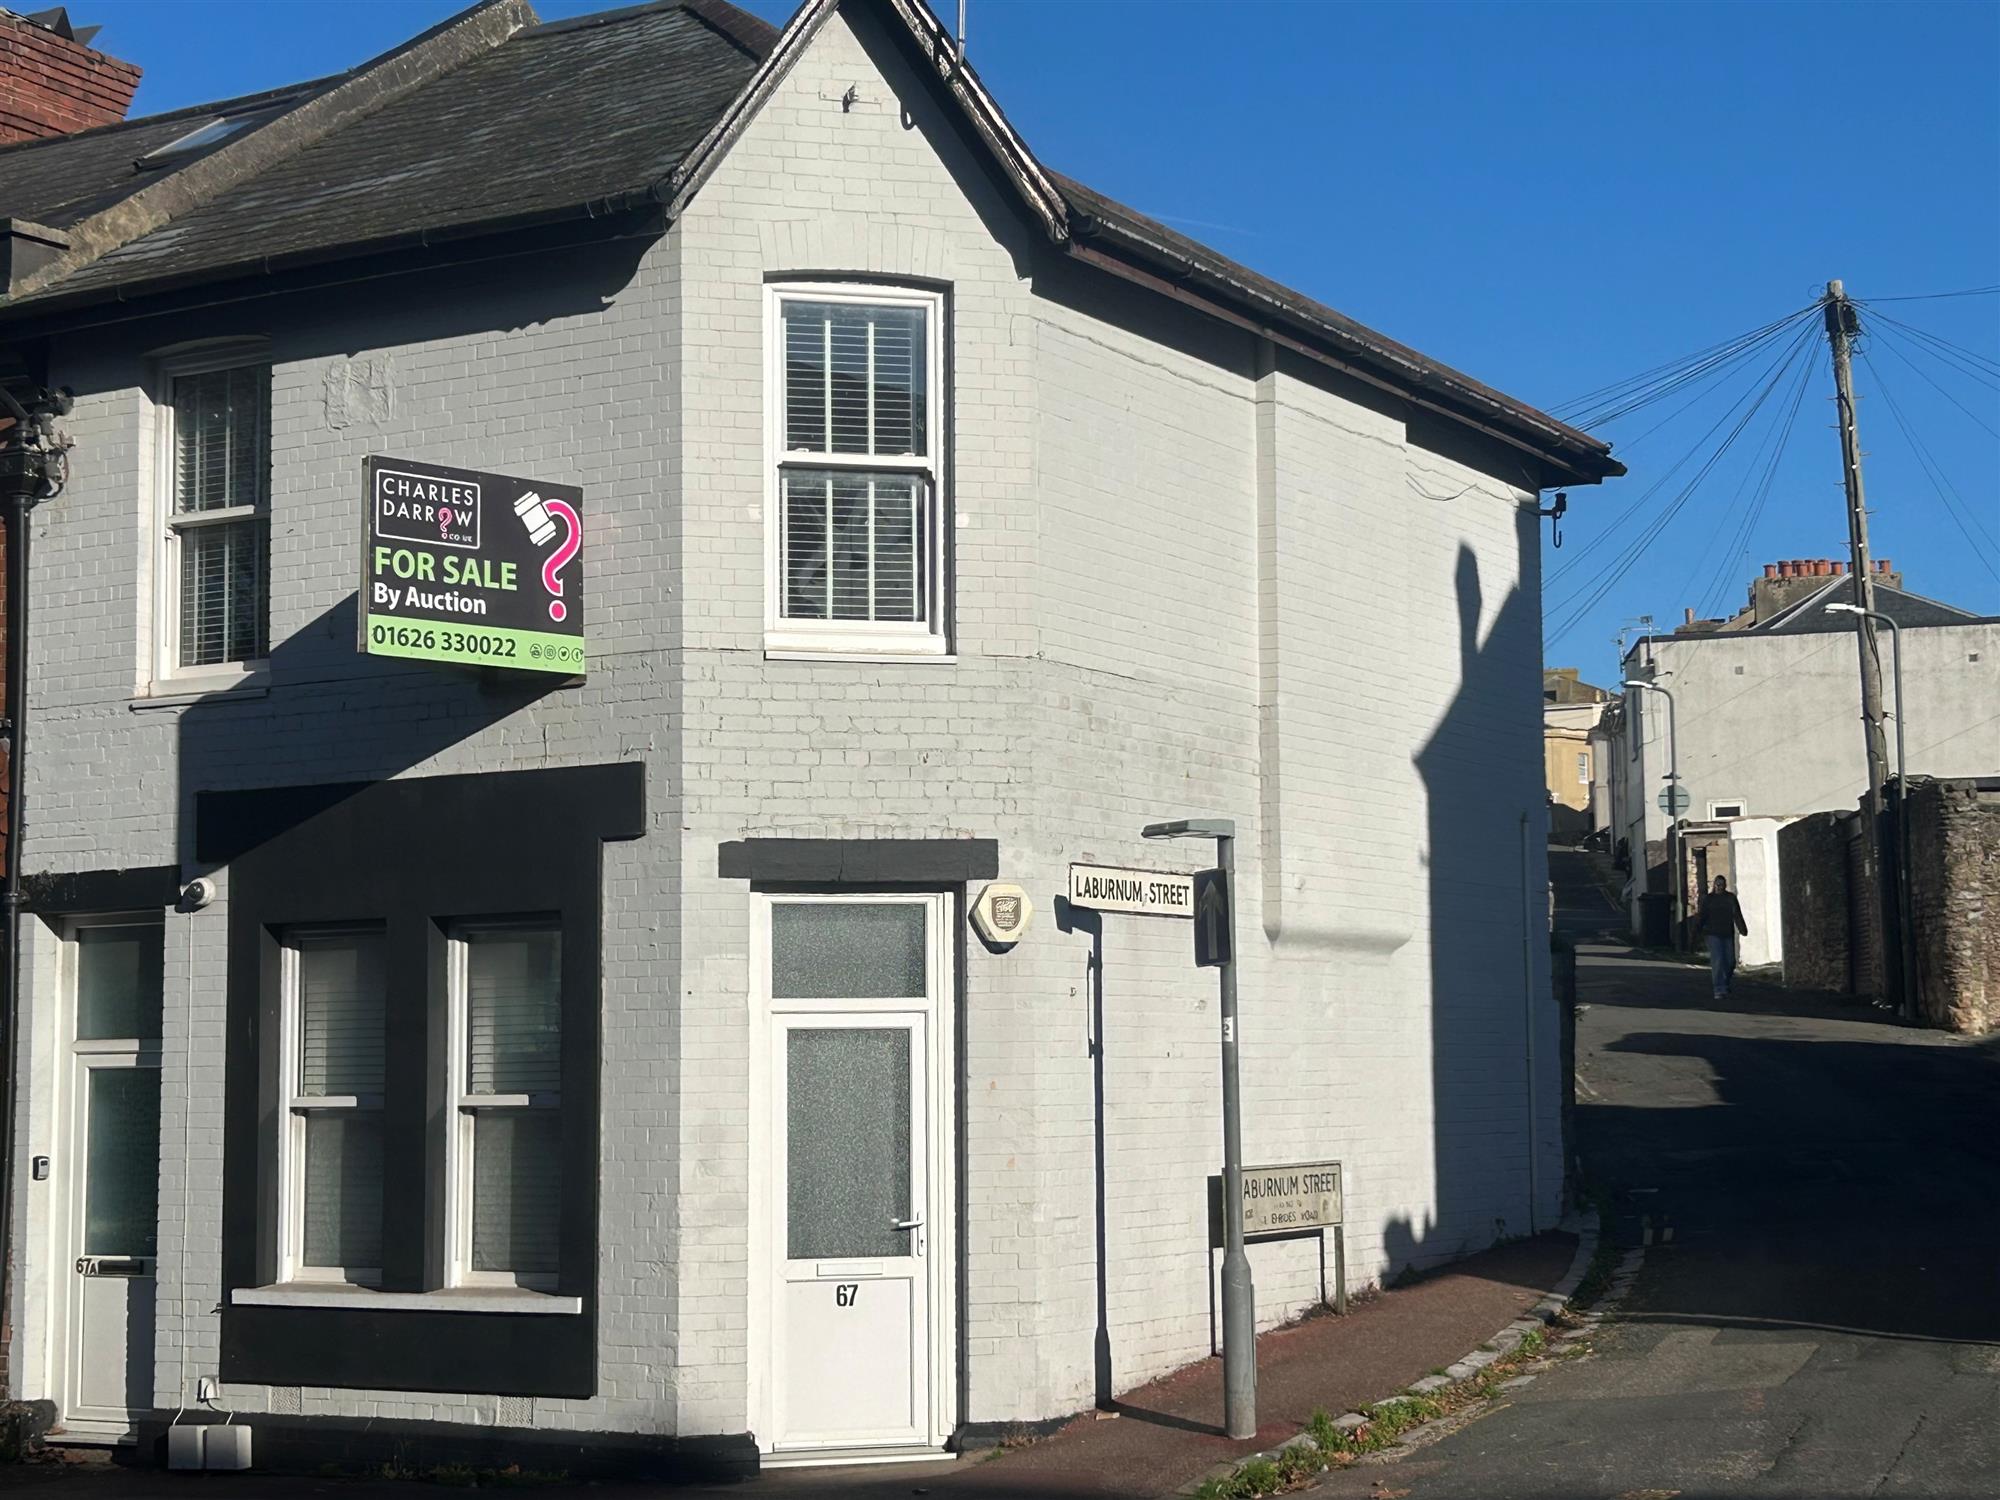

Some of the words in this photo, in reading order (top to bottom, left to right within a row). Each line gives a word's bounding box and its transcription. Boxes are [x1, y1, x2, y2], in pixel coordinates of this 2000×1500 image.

[383, 478, 473, 506] CHARLES
[375, 546, 435, 582] FOR
[443, 556, 517, 591] SALE
[374, 582, 401, 610] By
[405, 586, 487, 615] Auction
[373, 624, 435, 648] 01626
[441, 632, 516, 657] 330022
[1075, 875, 1143, 902] LABURNUM
[1149, 883, 1189, 906] STREET
[1243, 1175, 1298, 1200] ABURNUM
[1302, 1173, 1337, 1194] STREET
[76, 1258, 97, 1274] 67A
[836, 1284, 858, 1307] 67
